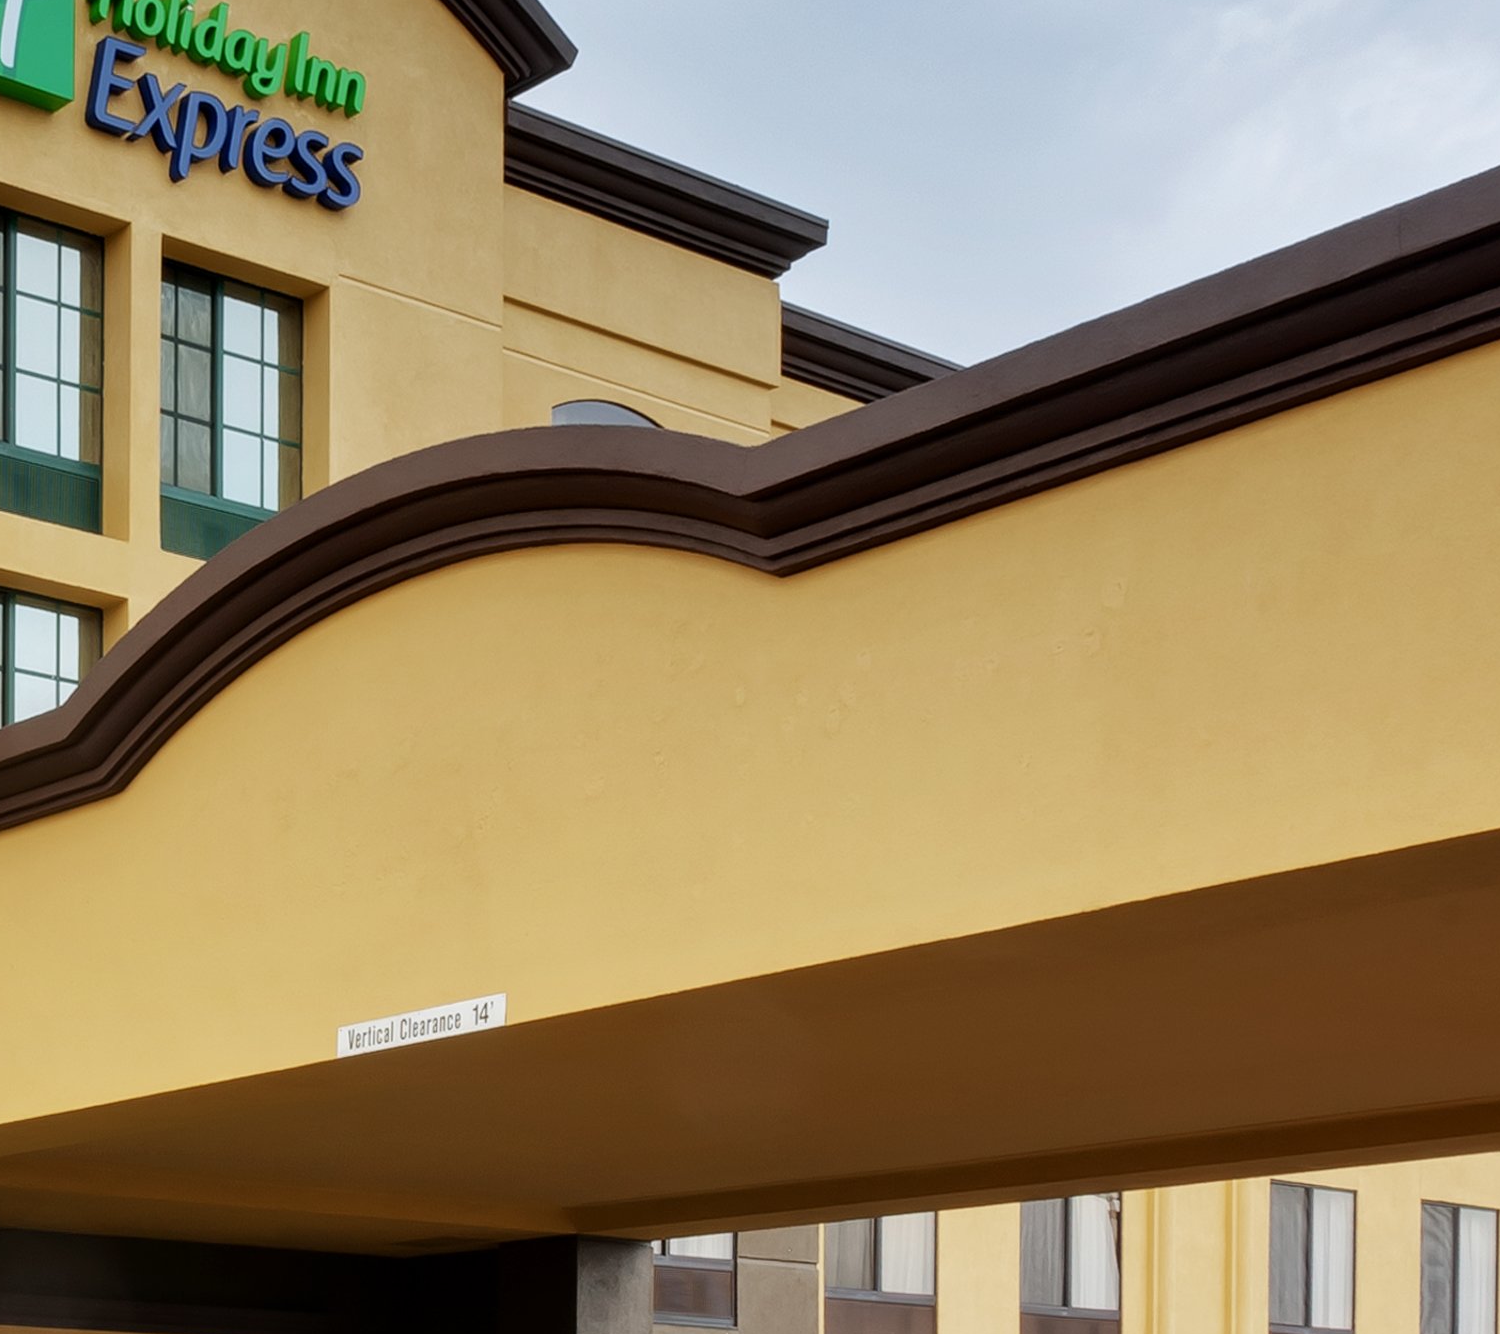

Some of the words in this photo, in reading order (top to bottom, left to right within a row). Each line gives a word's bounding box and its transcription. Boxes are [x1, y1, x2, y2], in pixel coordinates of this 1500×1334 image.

[285, 31, 366, 118] Inn
[85, 35, 364, 211] Express
[348, 1021, 394, 1051] Vertical
[399, 1012, 462, 1041] Clearance
